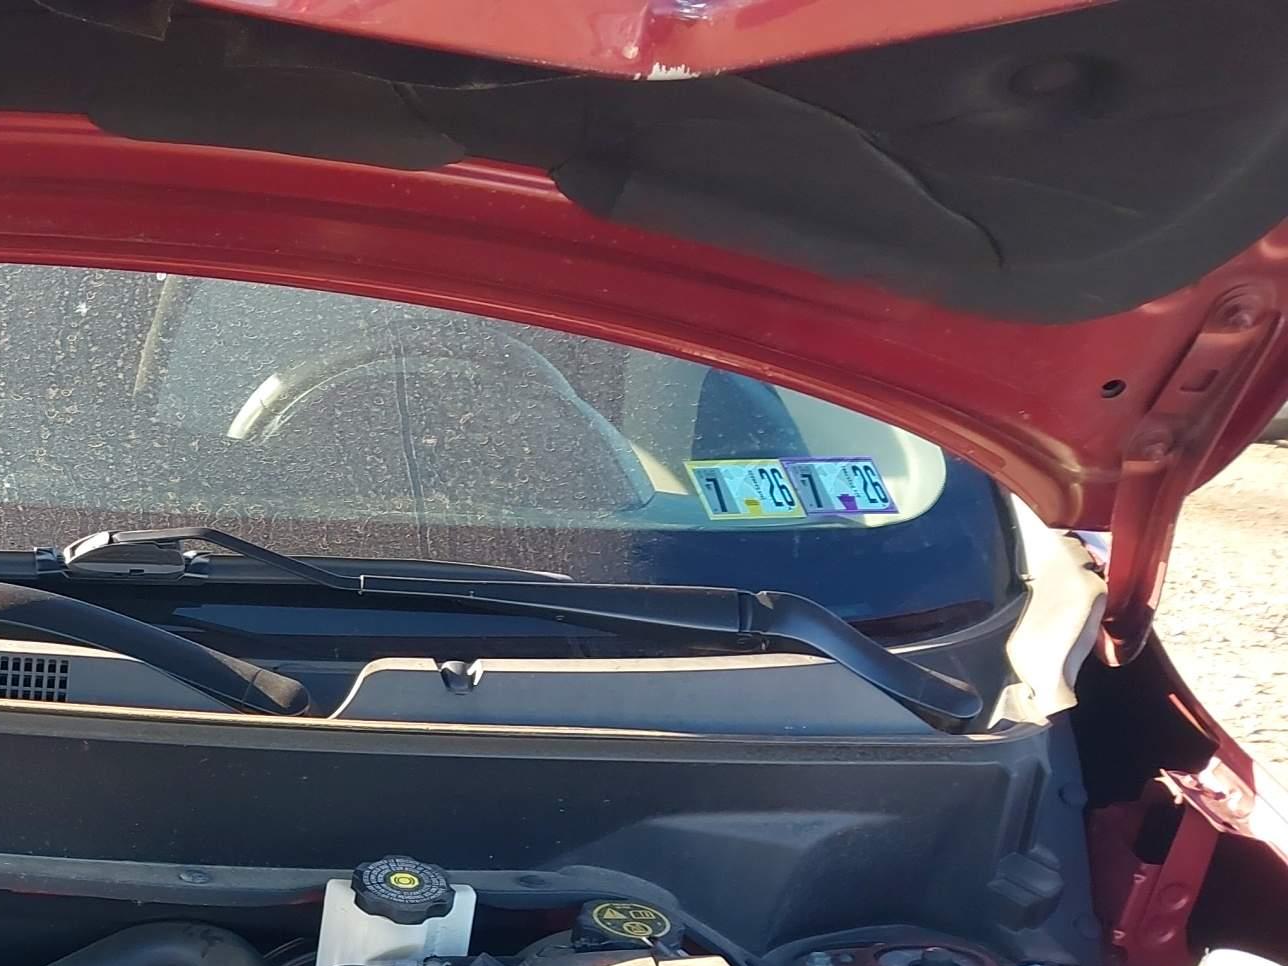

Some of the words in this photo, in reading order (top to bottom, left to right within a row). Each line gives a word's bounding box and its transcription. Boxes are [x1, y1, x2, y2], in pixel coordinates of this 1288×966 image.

[706, 478, 727, 512] 7
[759, 468, 795, 507] 26
[800, 474, 823, 508] 7
[852, 465, 888, 504] 26
